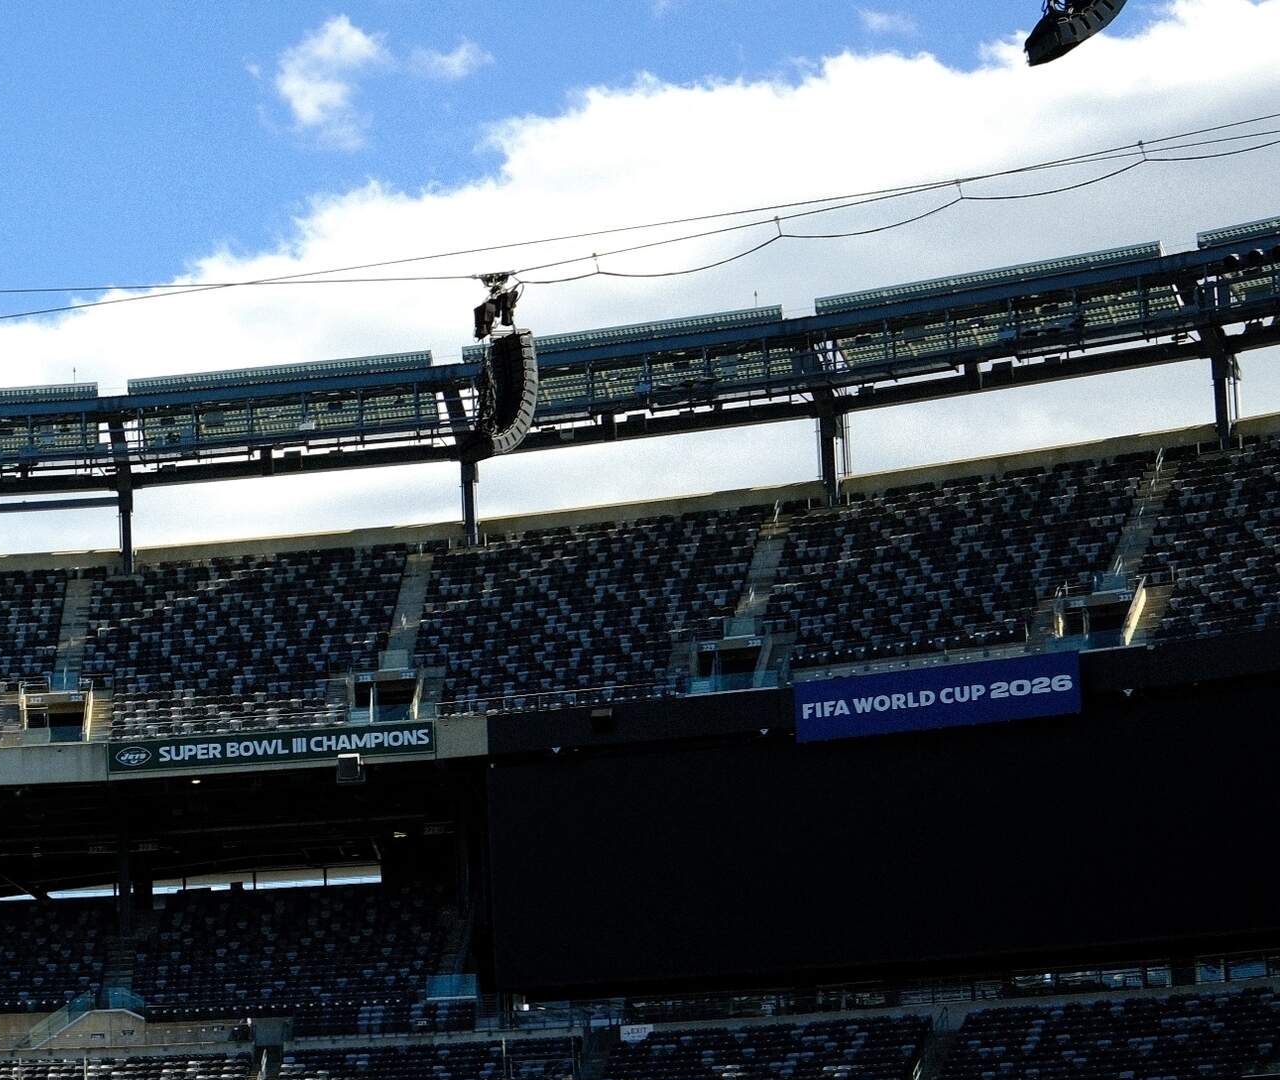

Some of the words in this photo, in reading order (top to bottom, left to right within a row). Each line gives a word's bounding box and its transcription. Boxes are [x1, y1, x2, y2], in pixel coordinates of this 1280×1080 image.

[802, 699, 851, 719] FIFA
[852, 689, 936, 714] WORLD
[940, 684, 986, 705] CUP
[990, 674, 1073, 699] 2026
[159, 743, 221, 763] SUPER
[226, 739, 289, 758] BOWL
[292, 737, 307, 753] III
[310, 729, 430, 752] CHAMPIONS
